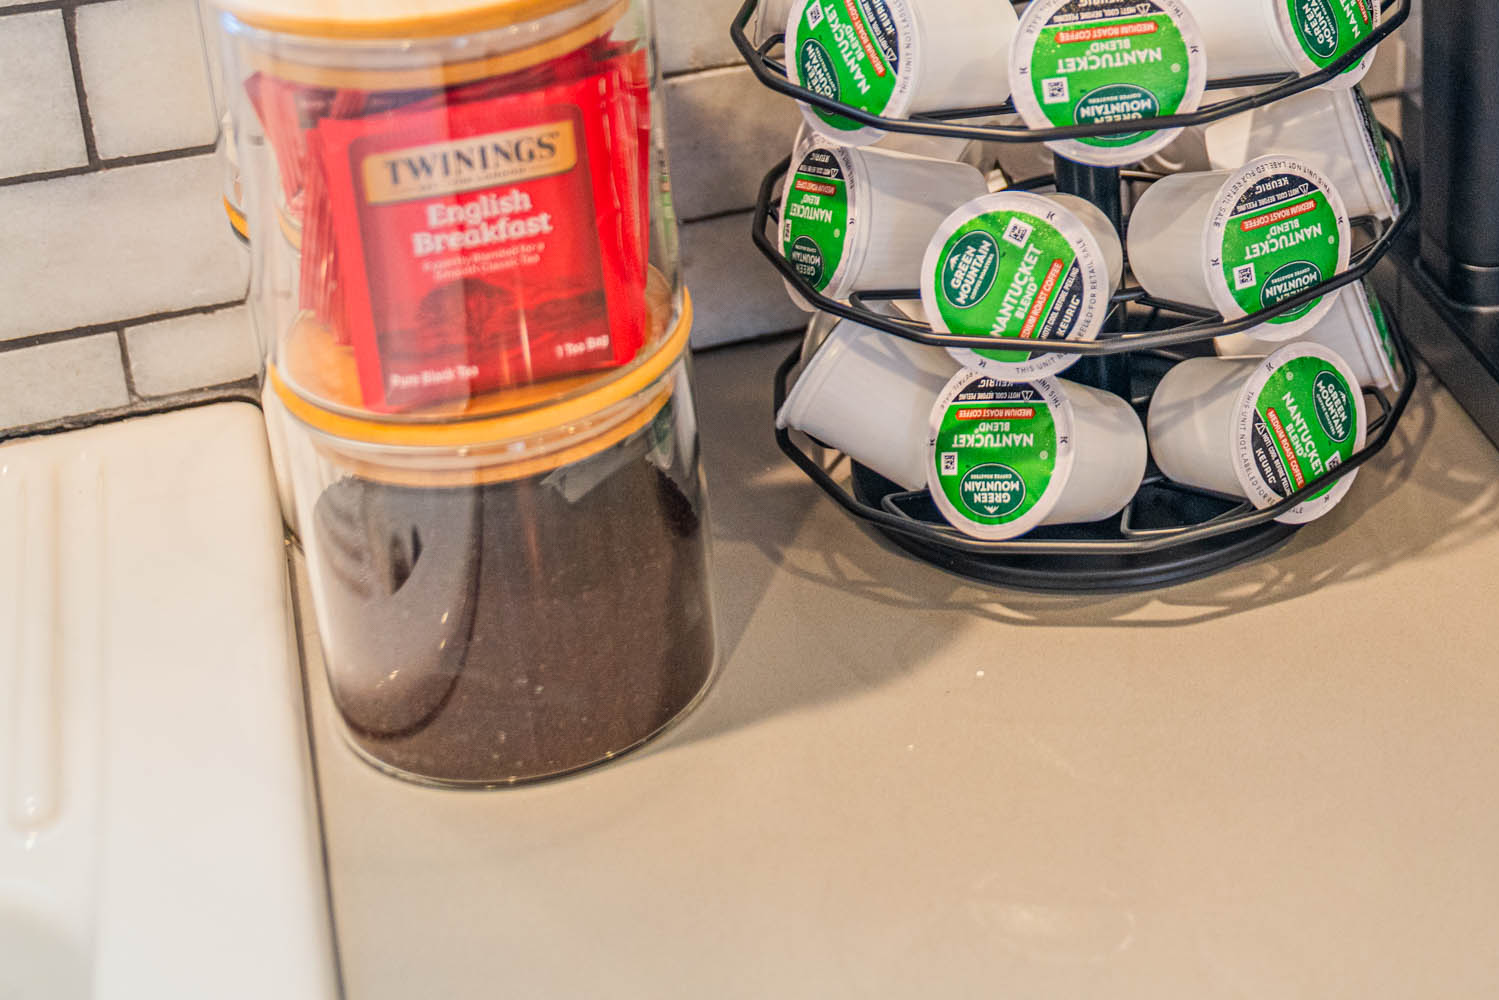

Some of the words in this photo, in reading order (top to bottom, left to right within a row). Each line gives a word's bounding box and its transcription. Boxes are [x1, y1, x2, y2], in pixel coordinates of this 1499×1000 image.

[854, 19, 870, 43] ROAST
[1059, 29, 1091, 42] COFFEE
[1091, 26, 1119, 38] ROAST
[1120, 21, 1154, 34] MEDIUM
[1301, 3, 1325, 43] GREEN
[824, 3, 871, 93] NANTUCKET
[866, 42, 884, 73] MEDIUM
[1055, 46, 1161, 73] NANTUCKET
[1079, 98, 1152, 118] MOUNTAIN
[387, 136, 557, 184] TWININGS
[1254, 176, 1289, 193] KEURIG
[427, 189, 532, 228] English
[788, 203, 832, 221] NANTUCKET
[1269, 209, 1290, 221] ROAST
[1290, 200, 1315, 214] MEDIUM
[413, 212, 553, 256] Breakfast
[1243, 215, 1269, 229] COFFEE
[1242, 223, 1323, 258] NANTUCKET
[949, 245, 976, 289] GREEN
[955, 239, 991, 304] MOUNTAIN
[1063, 266, 1079, 290] PEELING
[989, 243, 1042, 338] NANTUCKET
[1264, 271, 1317, 296] MOUNTAIN
[1021, 315, 1036, 338] EDIUM
[1031, 291, 1047, 316] ROAST
[1043, 262, 1061, 291] COFFEE
[1089, 293, 1097, 310] FOR
[1055, 295, 1080, 336] KEURIG
[958, 392, 975, 400] PEELING
[1315, 381, 1345, 437] MOUNTAIN
[1326, 383, 1348, 421] GREEN
[959, 410, 981, 418] COFFEE
[983, 409, 1004, 417] ROAST
[1006, 409, 1032, 417] MEDIUM
[952, 434, 1033, 448] NANTUCKET
[1281, 392, 1323, 475] NANTUCKET
[1285, 423, 1304, 456] BLEND
[1261, 433, 1271, 446] HOT!
[1267, 446, 1277, 459] COOL
[1273, 459, 1285, 477] BEFORE
[1267, 410, 1284, 439] MEDIUM
[1280, 438, 1294, 461] ROAST
[1289, 460, 1304, 486] COFFEE
[1241, 452, 1257, 486] LABELED
[1255, 448, 1275, 482] KEURIG
[965, 481, 1019, 492] MOUNTAIN
[974, 493, 1010, 503] GREEN
